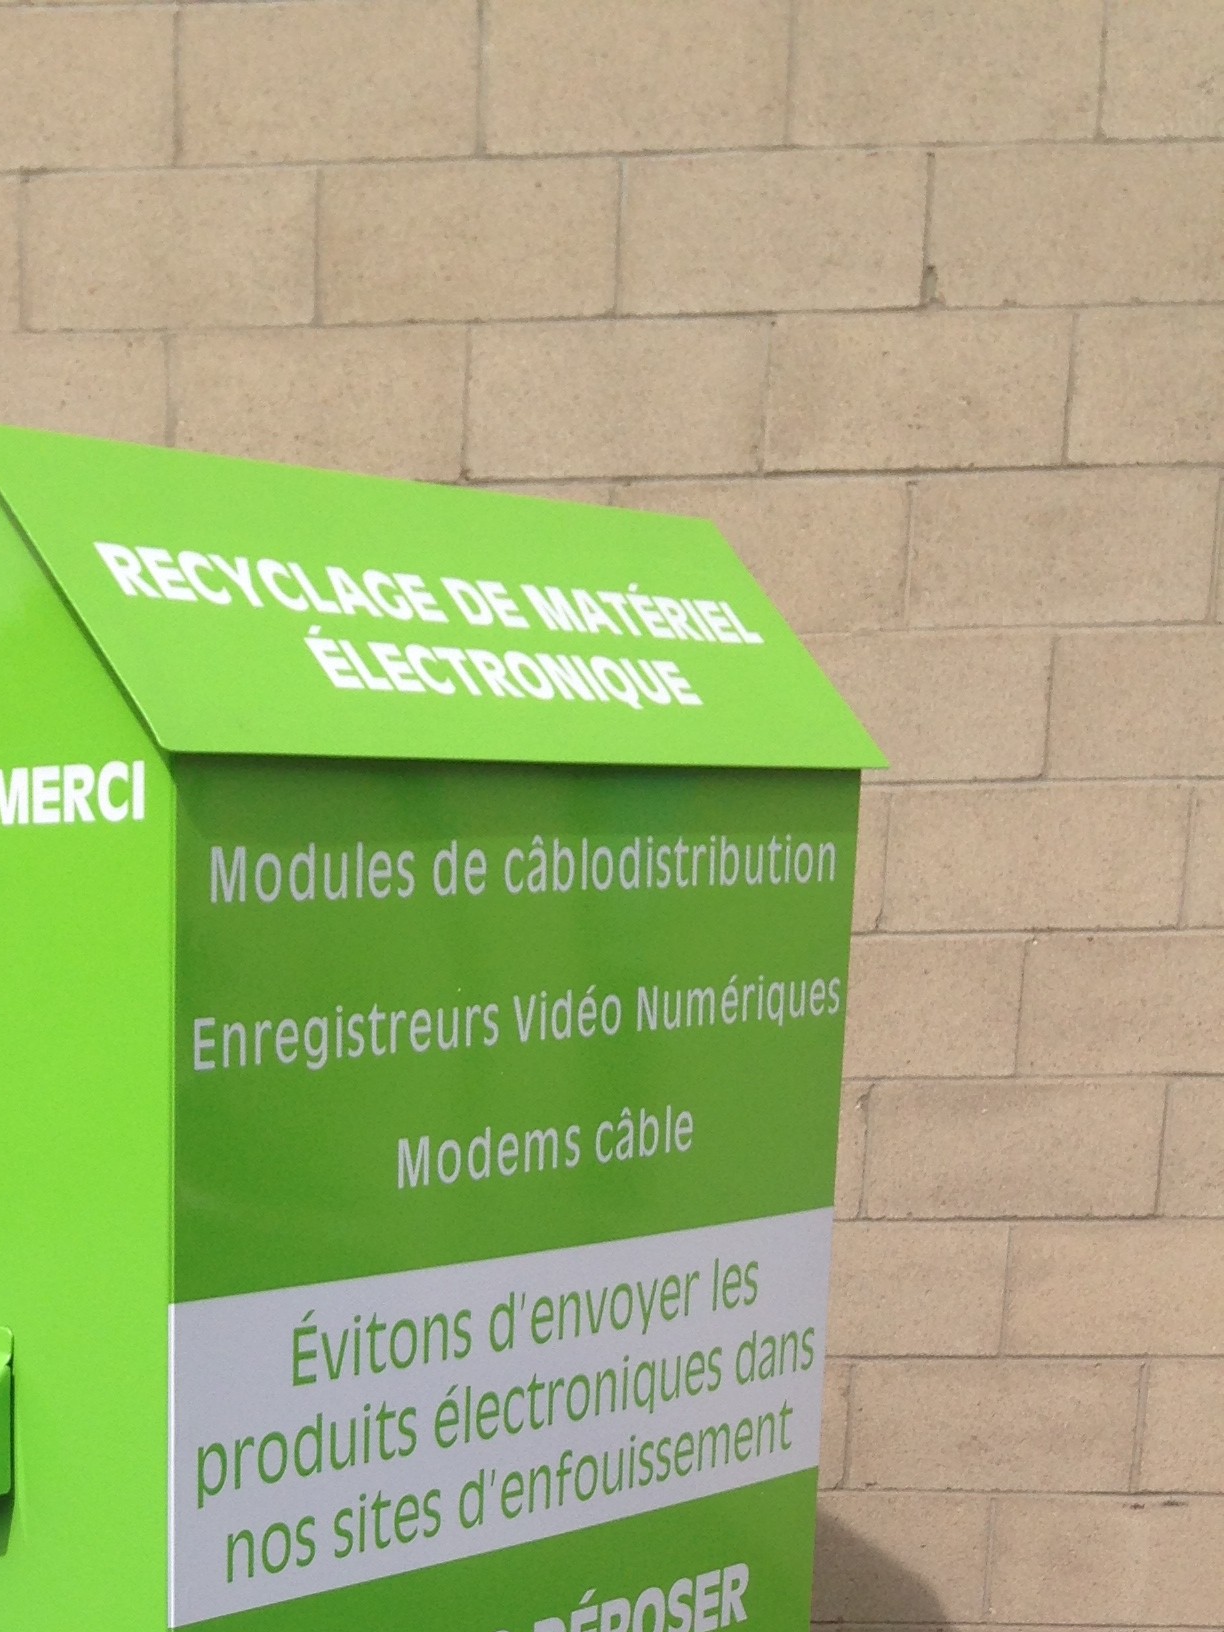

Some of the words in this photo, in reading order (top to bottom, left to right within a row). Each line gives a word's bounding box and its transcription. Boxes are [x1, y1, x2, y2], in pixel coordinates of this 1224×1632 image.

[93, 542, 448, 624] RECYCLAGE
[442, 577, 528, 629] DE
[524, 583, 764, 644] MATÉRIEL
[304, 626, 702, 710] ÉLECTRONIQUE
[210, 842, 415, 903] Modules
[434, 840, 486, 895] de
[505, 834, 836, 894] câblodistribution
[194, 1002, 498, 1071] Enregistreurs
[514, 987, 622, 1043] Vidéo
[637, 974, 840, 1032] Numériques
[397, 1125, 579, 1189] Modems
[596, 1105, 693, 1163] câble
[292, 1309, 472, 1386] Évitons
[489, 1272, 699, 1353] d'envoyer
[712, 1257, 759, 1311] les
[197, 1402, 417, 1509] produits
[434, 1341, 721, 1449] électroniques
[735, 1326, 815, 1385] dans
[227, 1515, 315, 1583] nos
[334, 1487, 441, 1560] sites
[459, 1399, 793, 1530] d'enfouissement
